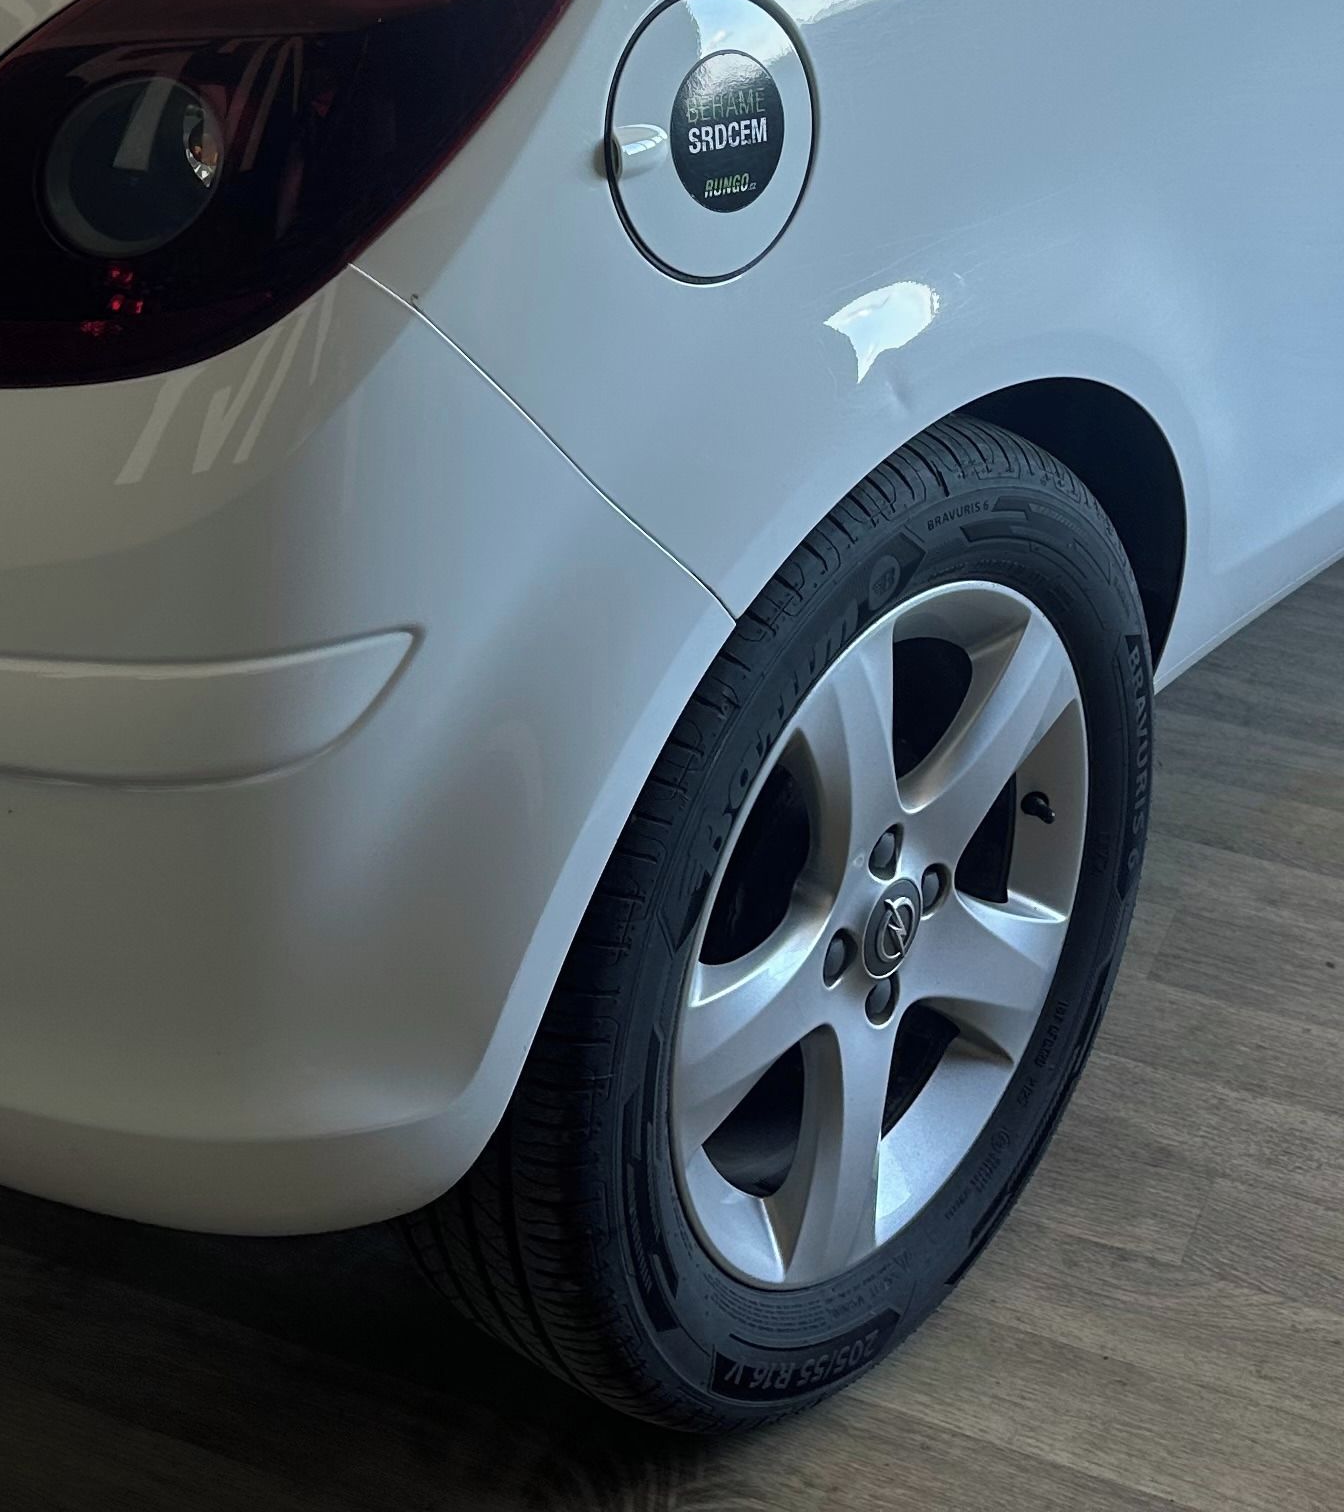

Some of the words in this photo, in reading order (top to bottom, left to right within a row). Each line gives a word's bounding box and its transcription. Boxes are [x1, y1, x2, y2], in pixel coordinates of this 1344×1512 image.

[688, 117, 768, 154] SRDCEM
[926, 502, 981, 531] BRAVURIS
[1126, 644, 1150, 836] BRAVURIS
[750, 1361, 796, 1390] R16
[796, 1329, 880, 1386] 205/55
